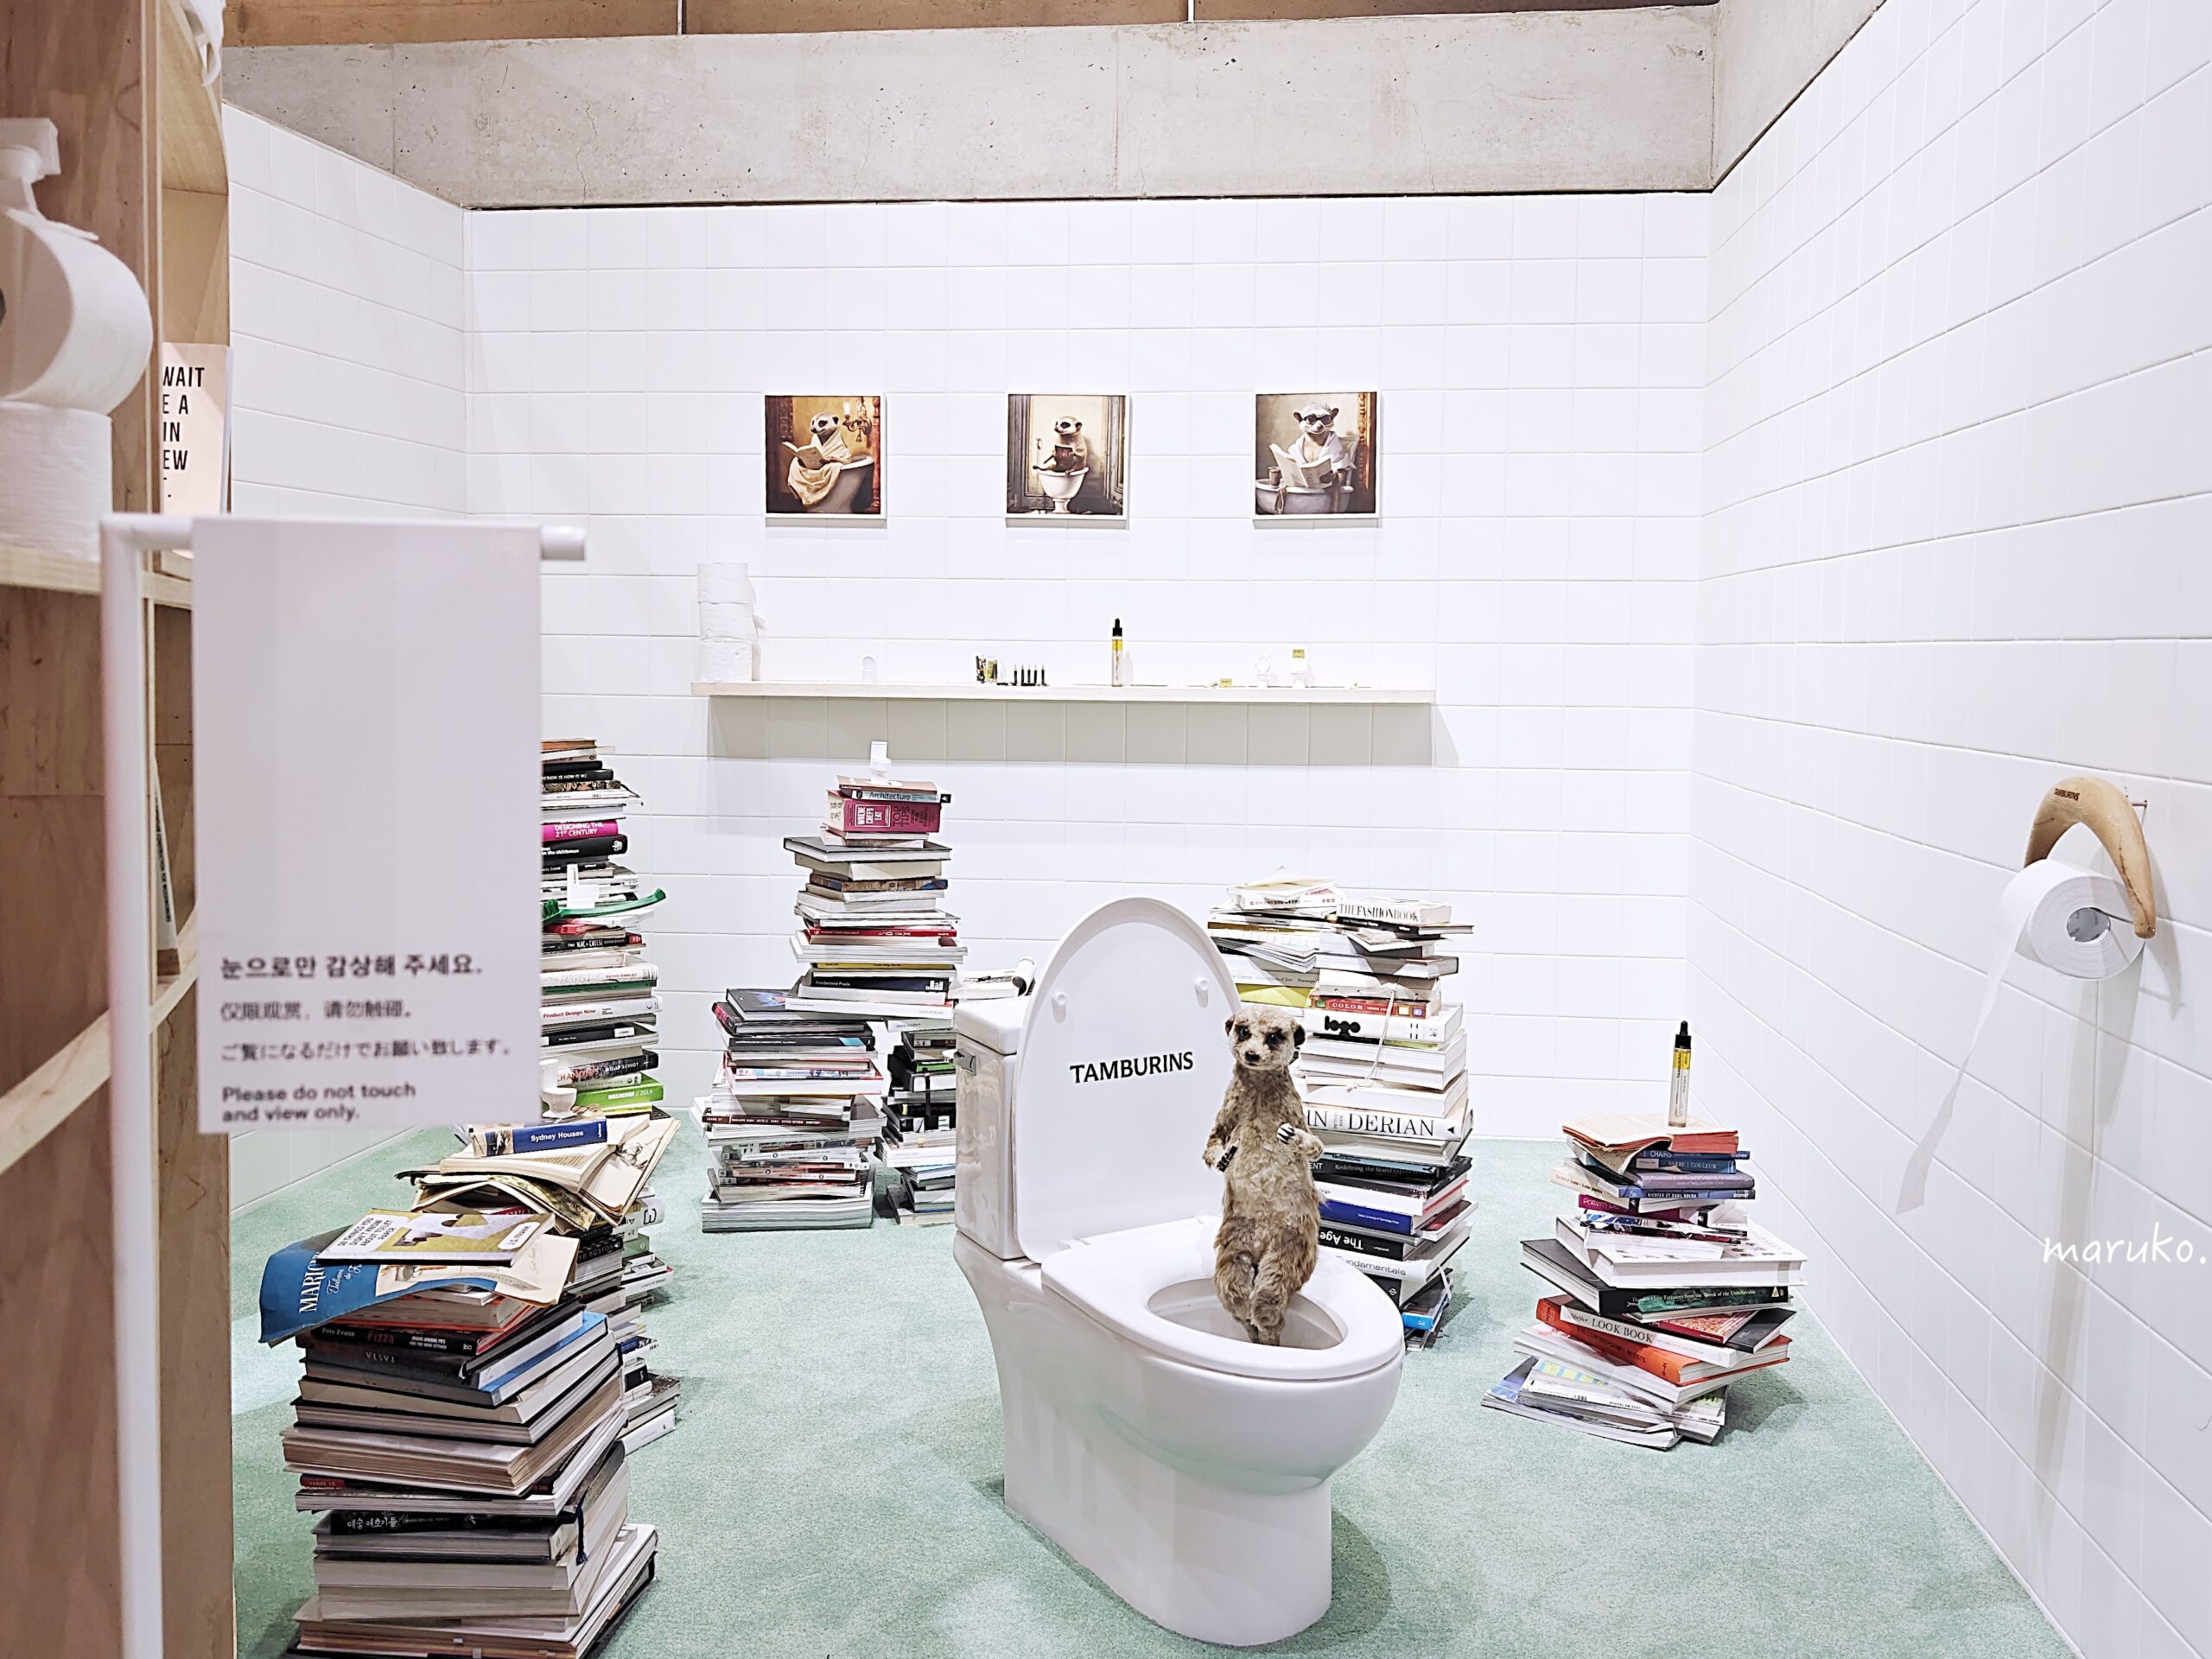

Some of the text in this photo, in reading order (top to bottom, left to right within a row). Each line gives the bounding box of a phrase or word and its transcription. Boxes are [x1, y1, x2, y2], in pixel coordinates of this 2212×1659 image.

[178, 395, 188, 415] A
[868, 791, 912, 801] Architecture
[893, 805, 901, 827] TOP
[901, 805, 910, 827] TIPS
[554, 822, 591, 831] DESIGNING
[569, 829, 598, 837] CENTURY
[220, 954, 482, 979] 눈으로만 감상해 주세요.
[1325, 1015, 1361, 1039] logo
[1070, 1052, 1194, 1084] TAMBURINS
[221, 1081, 416, 1103] Please do not touch
[221, 1103, 360, 1122] and view only.
[1349, 1113, 1435, 1136] DERIAN
[531, 1129, 584, 1143] Sydney Houses
[1334, 1163, 1364, 1173] Redefining
[1319, 1230, 1341, 1245] Age
[1344, 1236, 1363, 1250] The
[1592, 1318, 1620, 1334] LOOK
[1624, 1327, 1654, 1344] BOOK
